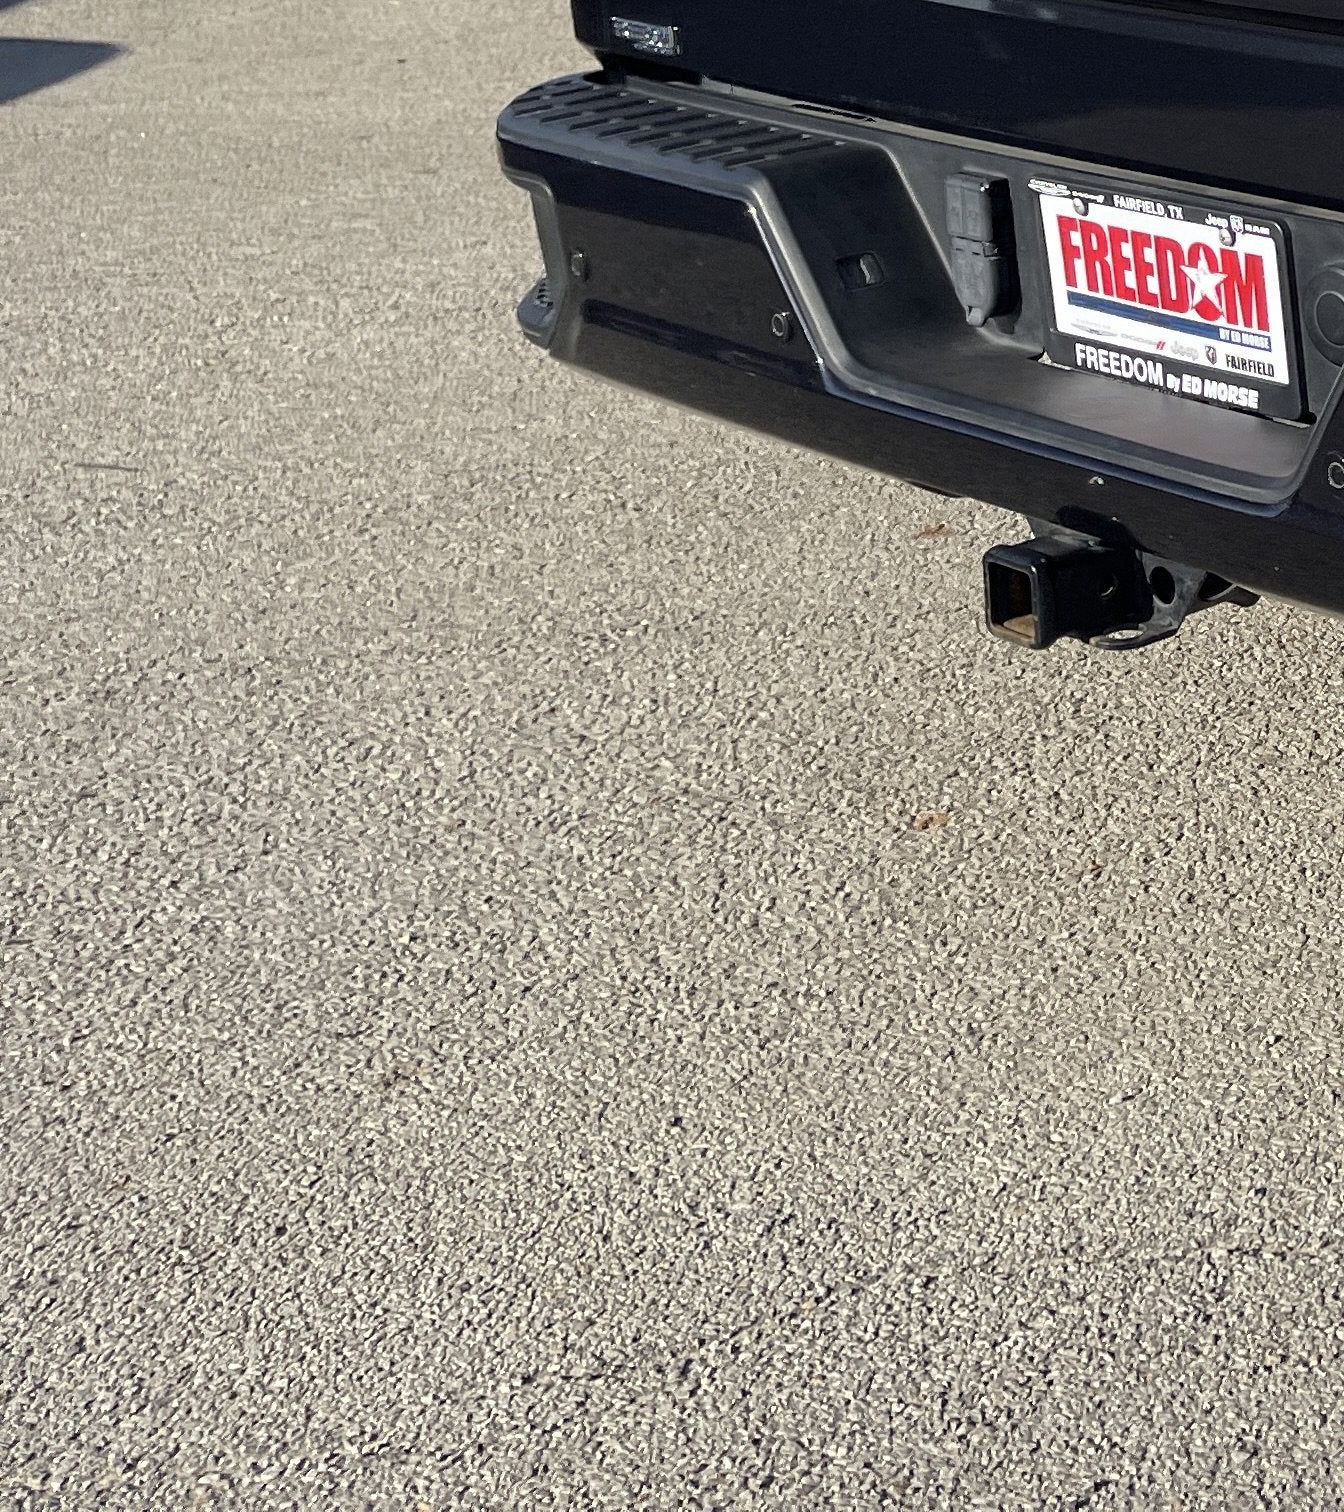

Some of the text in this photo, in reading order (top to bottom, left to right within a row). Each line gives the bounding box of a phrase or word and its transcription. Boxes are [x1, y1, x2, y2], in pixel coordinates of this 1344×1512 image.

[1113, 194, 1184, 220] FAIRFIELD, TX
[1056, 214, 1270, 332] FREEDOM
[1074, 342, 1164, 387] FREEDOM
[1182, 373, 1202, 396] ED
[1203, 378, 1259, 409] MORSE
[1225, 352, 1275, 378] FAIRFIELD
